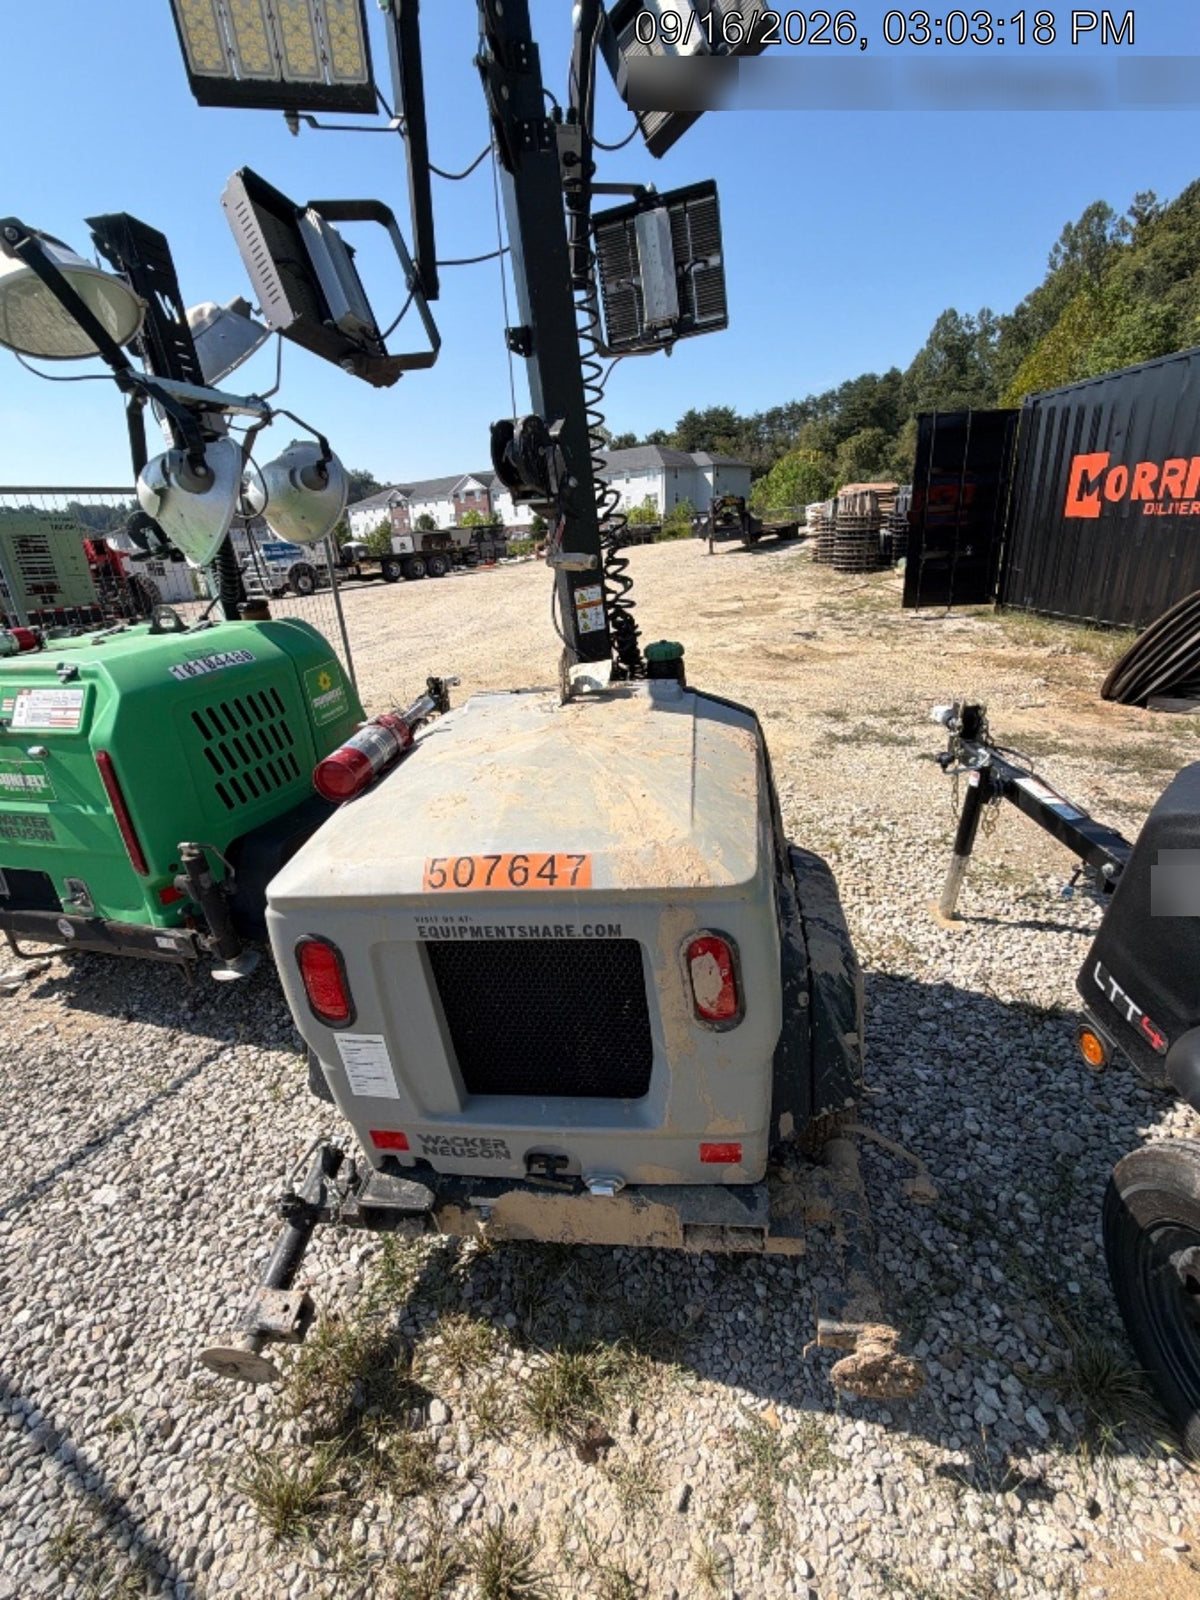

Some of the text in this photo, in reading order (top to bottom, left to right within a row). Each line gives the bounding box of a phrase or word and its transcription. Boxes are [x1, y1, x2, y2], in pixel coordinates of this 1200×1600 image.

[427, 854, 587, 889] 507647
[417, 924, 622, 939] EQUIPMENTSHARE.COM
[416, 1133, 508, 1149] WACKER
[422, 1144, 513, 1160] NEUSON
